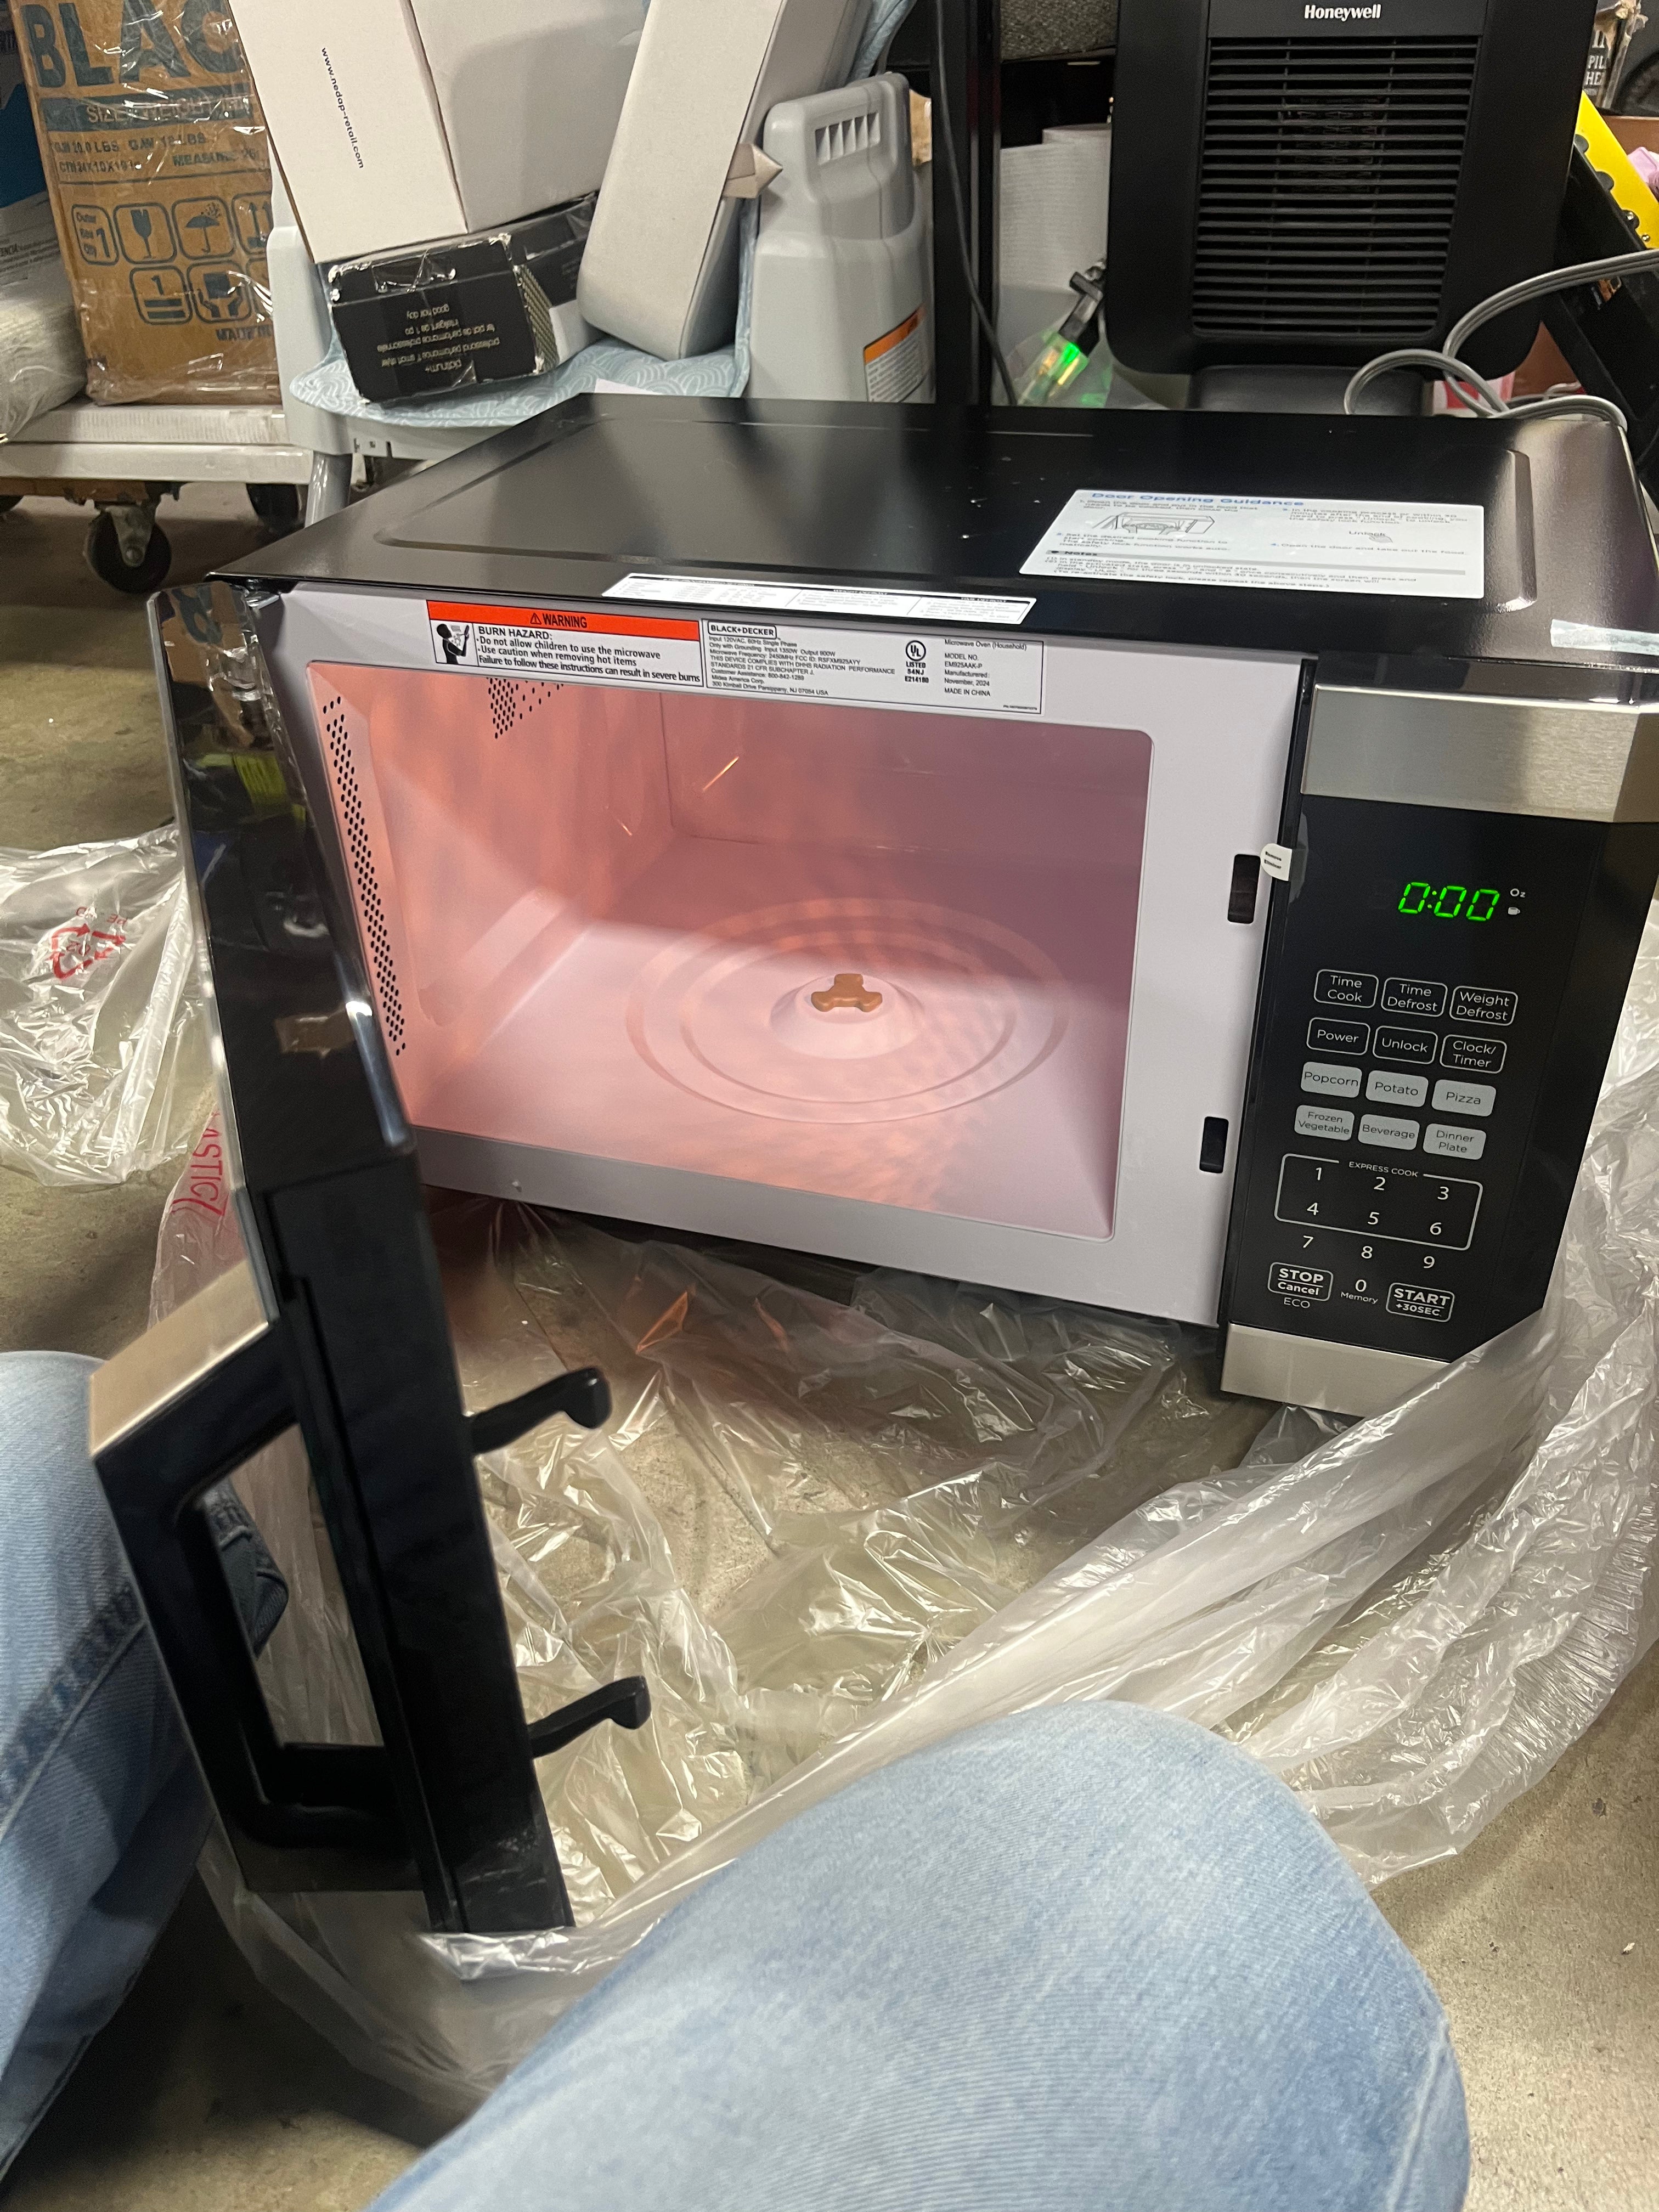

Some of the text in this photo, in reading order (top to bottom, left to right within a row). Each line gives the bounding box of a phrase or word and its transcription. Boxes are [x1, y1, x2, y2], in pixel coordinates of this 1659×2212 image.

[1304, 4, 1381, 21] Honeywell
[321, 47, 364, 168] www.nedap-retail.com
[96, 227, 110, 258] 1
[151, 276, 165, 295] 1
[1140, 494, 1214, 504] Opening
[542, 613, 588, 629] WARNING
[478, 625, 553, 640] BURN HAZARD:
[710, 625, 774, 635] BLACK+DECKER
[493, 637, 507, 646] not
[509, 639, 532, 648] allow
[534, 641, 568, 651] children
[569, 644, 579, 652] to
[581, 645, 595, 653] use
[597, 646, 612, 655] the
[613, 647, 661, 659] microwave
[992, 642, 1027, 651] (Household)
[498, 646, 530, 657] caution
[532, 650, 553, 659] when
[555, 651, 595, 664] removing
[596, 655, 611, 664] hot
[613, 657, 636, 667] items
[478, 654, 700, 682] Failure to follow these instructions can result in severe burns
[769, 666, 808, 674] SUBCHAPTER
[849, 665, 895, 674] PERFORMANCE
[944, 678, 974, 686] November,
[1510, 888, 1526, 898] Oz
[1398, 881, 1500, 921] 0:00
[1330, 975, 1362, 988] Time
[1327, 989, 1363, 1002] Cook
[1399, 983, 1432, 997] Time
[1387, 996, 1438, 1012] Defrost
[1460, 991, 1510, 1008] Weight
[1456, 1005, 1509, 1021] Defrost
[1317, 1029, 1359, 1043] Power
[1381, 1037, 1428, 1053] Unlock
[1453, 1041, 1497, 1055] Clock/
[1452, 1053, 1492, 1068] Timer
[1304, 1071, 1359, 1088] Popcorn
[1375, 1082, 1419, 1096] Potato
[1446, 1092, 1481, 1105] Pizza
[1308, 1111, 1343, 1124] Frozen
[1298, 1120, 1350, 1135] Vegetable
[1363, 1124, 1415, 1139] Beverage
[1436, 1130, 1475, 1143] Dinner
[1438, 1142, 1468, 1153] Plate
[1348, 1161, 1419, 1177] EXPRESS COOK
[1316, 1167, 1449, 1200] 1 2 3
[1307, 1203, 1442, 1235] 4 5 6
[1302, 1235, 1435, 1269] 7 8 9
[1279, 1268, 1324, 1284] STOP
[1278, 1281, 1319, 1296] Cancel
[1355, 1279, 1367, 1293] 0
[1284, 1297, 1311, 1309] ECO
[1341, 1291, 1379, 1305] Memory
[1393, 1288, 1451, 1306] START
